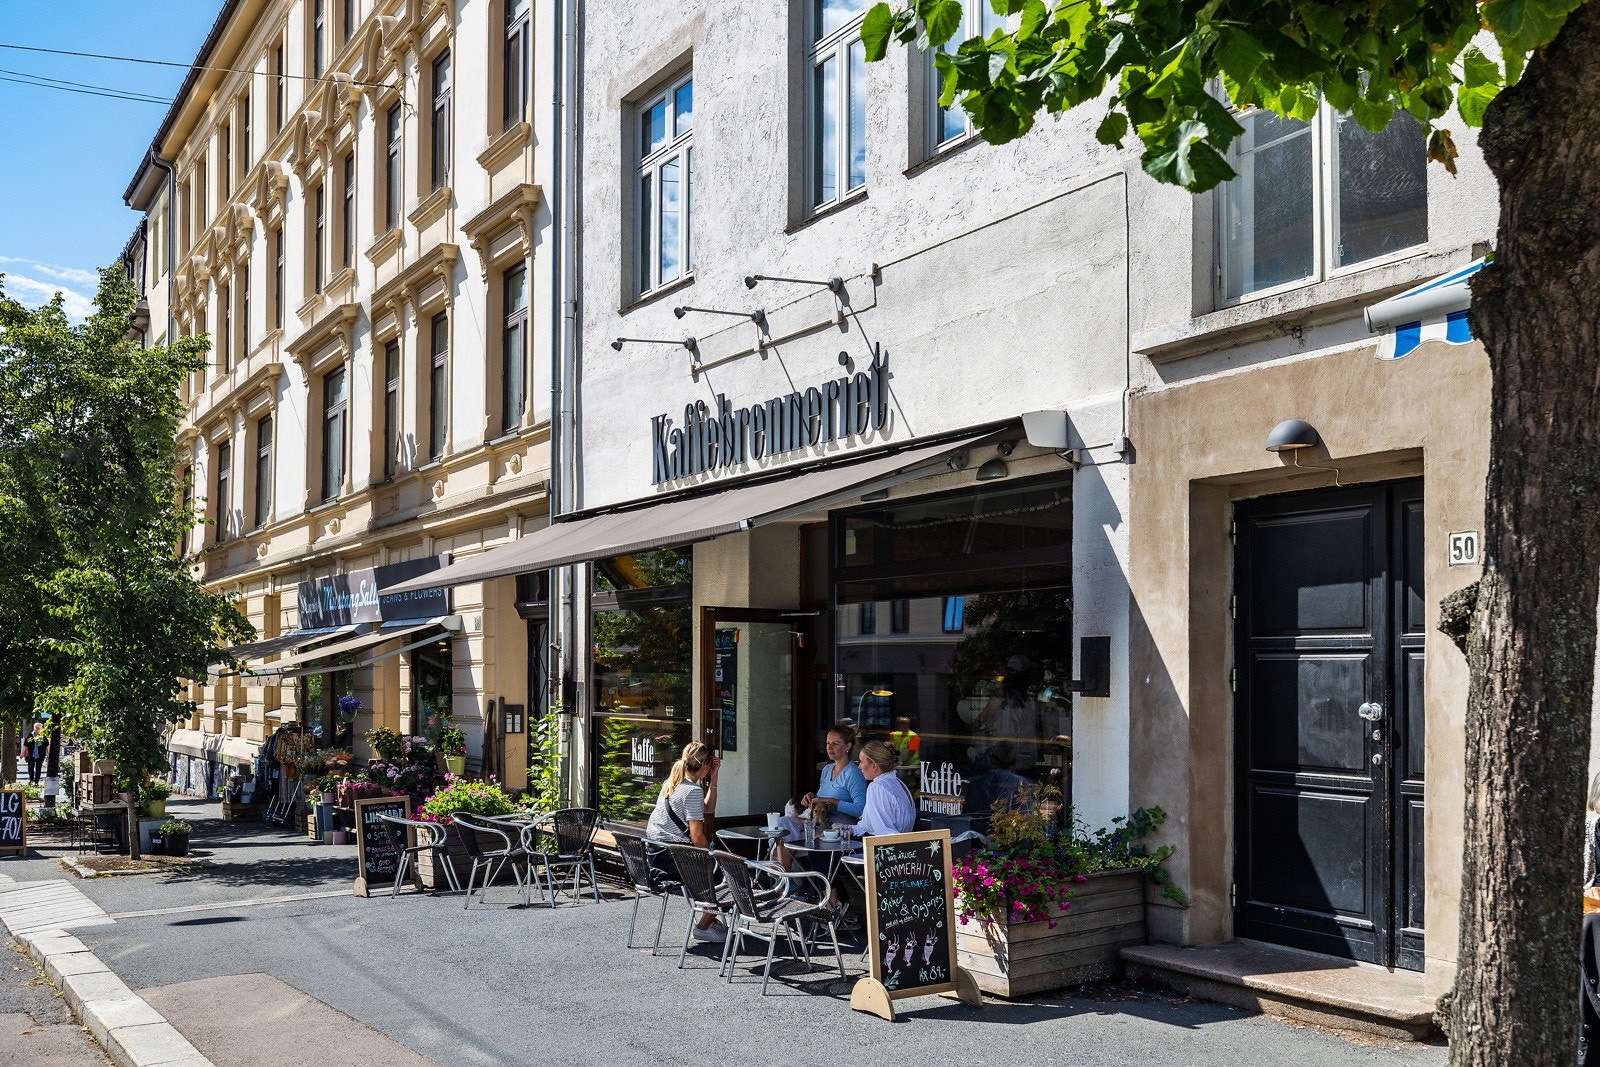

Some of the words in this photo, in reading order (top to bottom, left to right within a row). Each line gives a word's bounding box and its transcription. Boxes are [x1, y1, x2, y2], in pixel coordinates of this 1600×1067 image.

[651, 341, 889, 486] Kaffebrenneriet
[1453, 536, 1474, 561] 50
[631, 737, 655, 763] Kaffe
[920, 760, 962, 797] Kaffe
[1, 792, 20, 813] LG
[920, 795, 962, 815] brenneriet
[900, 903, 909, 916] &
